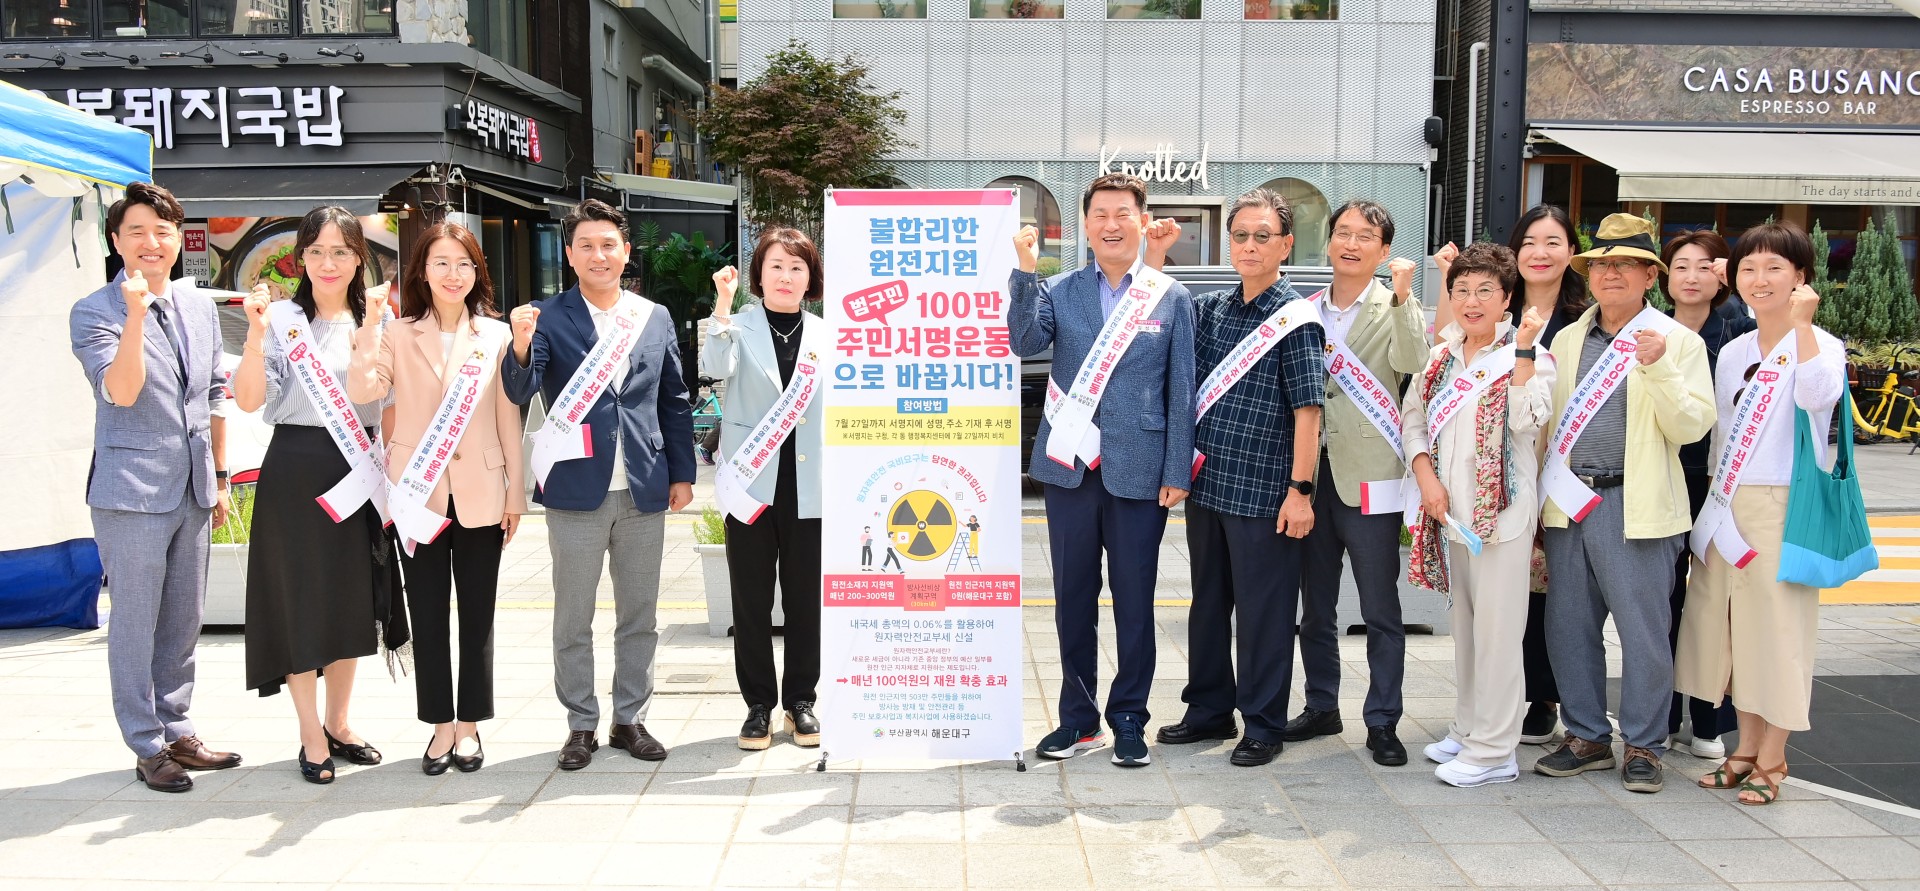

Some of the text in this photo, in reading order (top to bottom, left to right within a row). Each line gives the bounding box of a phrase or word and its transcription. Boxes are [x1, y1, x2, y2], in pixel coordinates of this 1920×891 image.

[1684, 67, 1774, 92] CASA
[1741, 100, 1877, 114] ESPRESSO BAR
[466, 100, 529, 157] 오복돼지국밥
[1099, 141, 1209, 190] Knotted
[1802, 185, 1824, 196] The
[1829, 185, 1849, 200] day
[1854, 186, 1886, 197] starts
[1890, 186, 1912, 198] and
[870, 217, 979, 244] 불합리한
[186, 268, 207, 276] 주차장
[869, 250, 977, 276] 원전지원
[850, 284, 905, 317] 범구민
[917, 291, 1002, 319] 100만
[836, 326, 1010, 358] 주민서명운동
[1112, 332, 1130, 351] 주민
[1614, 341, 1635, 350] 범구민
[1239, 340, 1267, 370] 100만
[308, 352, 332, 387] 100만
[328, 387, 347, 409] 주민
[599, 361, 614, 383] 주민
[834, 363, 1013, 390] 으로 바꿉시다!
[1222, 366, 1240, 386] 주민
[1758, 372, 1778, 381] 범구민
[795, 378, 814, 411] 100만
[1346, 361, 1375, 391] 100만
[1371, 388, 1390, 409] 주민
[460, 379, 479, 414] 100만
[903, 400, 942, 412] 참여방법
[1559, 356, 1630, 455] 100만 주민 서명 운동
[1435, 394, 1464, 425] 100만
[449, 414, 465, 437] 주민
[780, 410, 798, 431] 주민
[835, 419, 1012, 429] 7월 27일까지 서명지에 성명, 주소 기재 후 서명
[953, 431, 962, 440] 7월
[964, 431, 990, 440] 27일까지
[1723, 386, 1774, 496] 100만 주민 서명 운동
[436, 438, 454, 461] 서명
[932, 454, 957, 469] 당연한
[957, 465, 988, 503] 권리입니다
[832, 581, 894, 589] 원전소재지 지원액
[907, 584, 940, 592] 방사선비상
[949, 581, 1015, 589] 원전 인근지역 지원액
[830, 592, 845, 600] 매년
[910, 592, 937, 600] 계획구역
[996, 592, 1012, 601] 포함)
[850, 619, 878, 629] 내국세
[882, 619, 910, 629] 총액의
[957, 619, 994, 629] 활용하여
[874, 633, 973, 642] 원자력안전교부세 신설
[851, 675, 1007, 687] 매년 100억원의 재원 확충 효과
[863, 693, 877, 701] 원전
[879, 693, 907, 701] 인근지역
[909, 693, 928, 701] 503만
[961, 693, 982, 701] 위하여
[879, 703, 899, 711] 방사능
[928, 703, 955, 711] 안전관리
[889, 729, 970, 739] 부산광역시 해운대구
